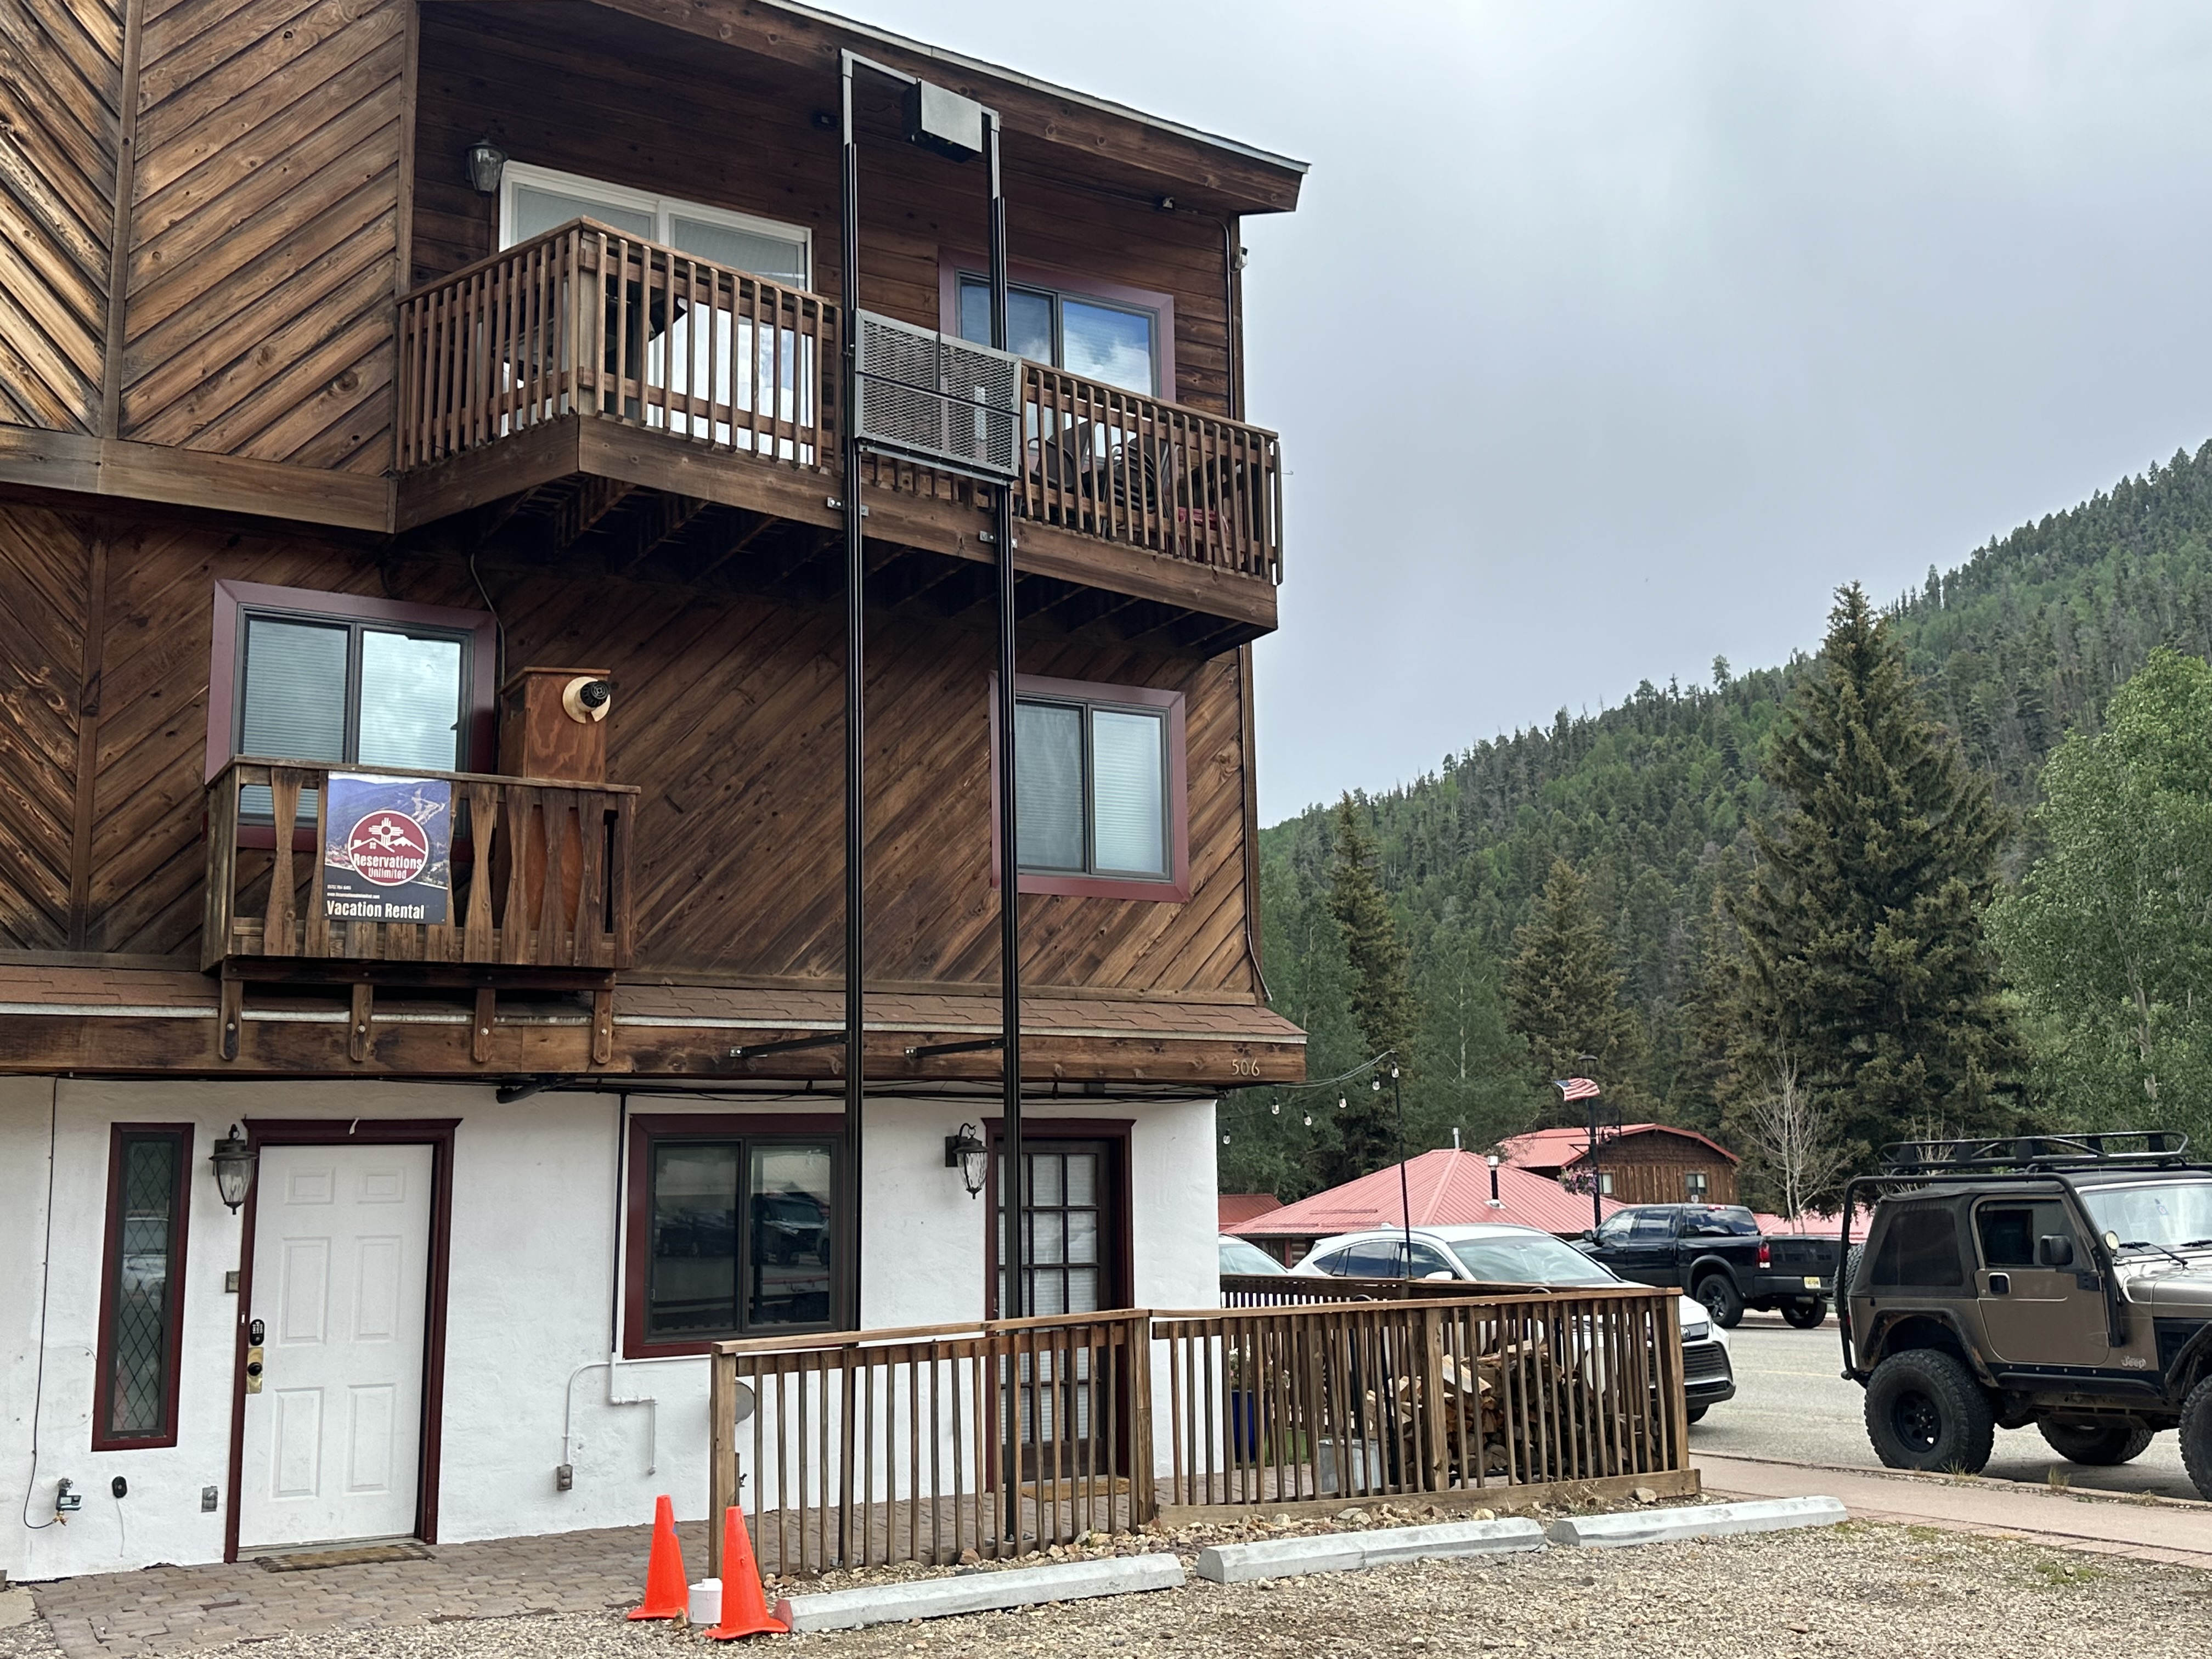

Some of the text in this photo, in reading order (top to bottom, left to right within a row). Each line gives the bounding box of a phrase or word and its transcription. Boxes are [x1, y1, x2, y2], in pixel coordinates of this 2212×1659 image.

[354, 853, 422, 870] Reservations
[368, 867, 407, 879] Unlimited
[327, 900, 425, 919] Vacation Rental
[1231, 1059, 1260, 1076] 506
[2121, 1355, 2146, 1369] Jeep
